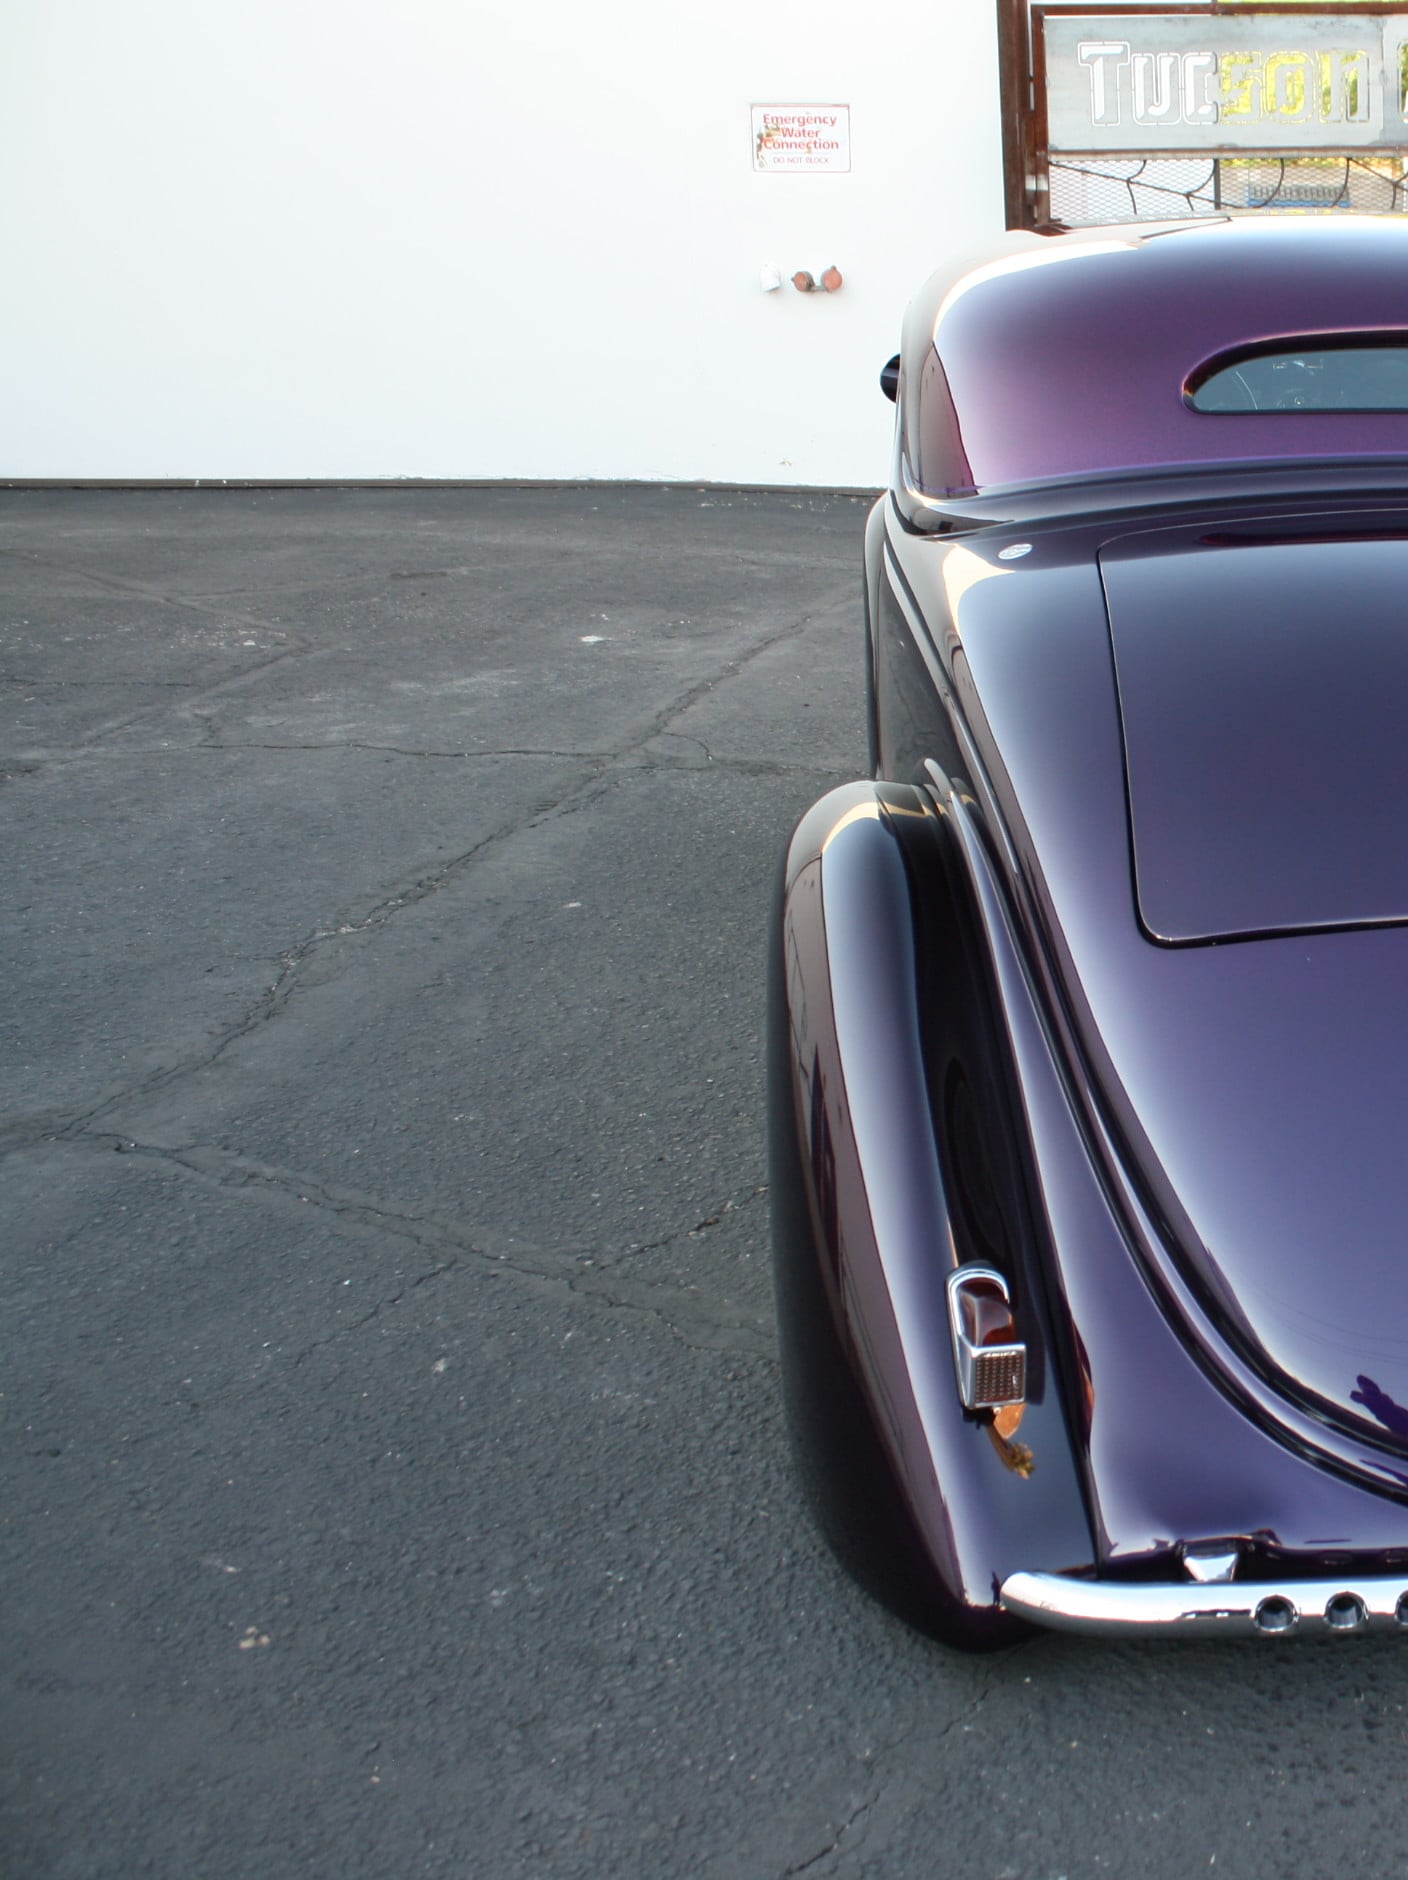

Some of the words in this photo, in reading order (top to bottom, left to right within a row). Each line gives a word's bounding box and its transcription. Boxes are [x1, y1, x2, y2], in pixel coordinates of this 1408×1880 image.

[763, 113, 837, 127] Emergency
[781, 127, 820, 138] Water
[763, 139, 839, 150] Connection
[773, 156, 785, 164] DO
[787, 156, 803, 164] NOT
[805, 156, 829, 164] BLOCK
